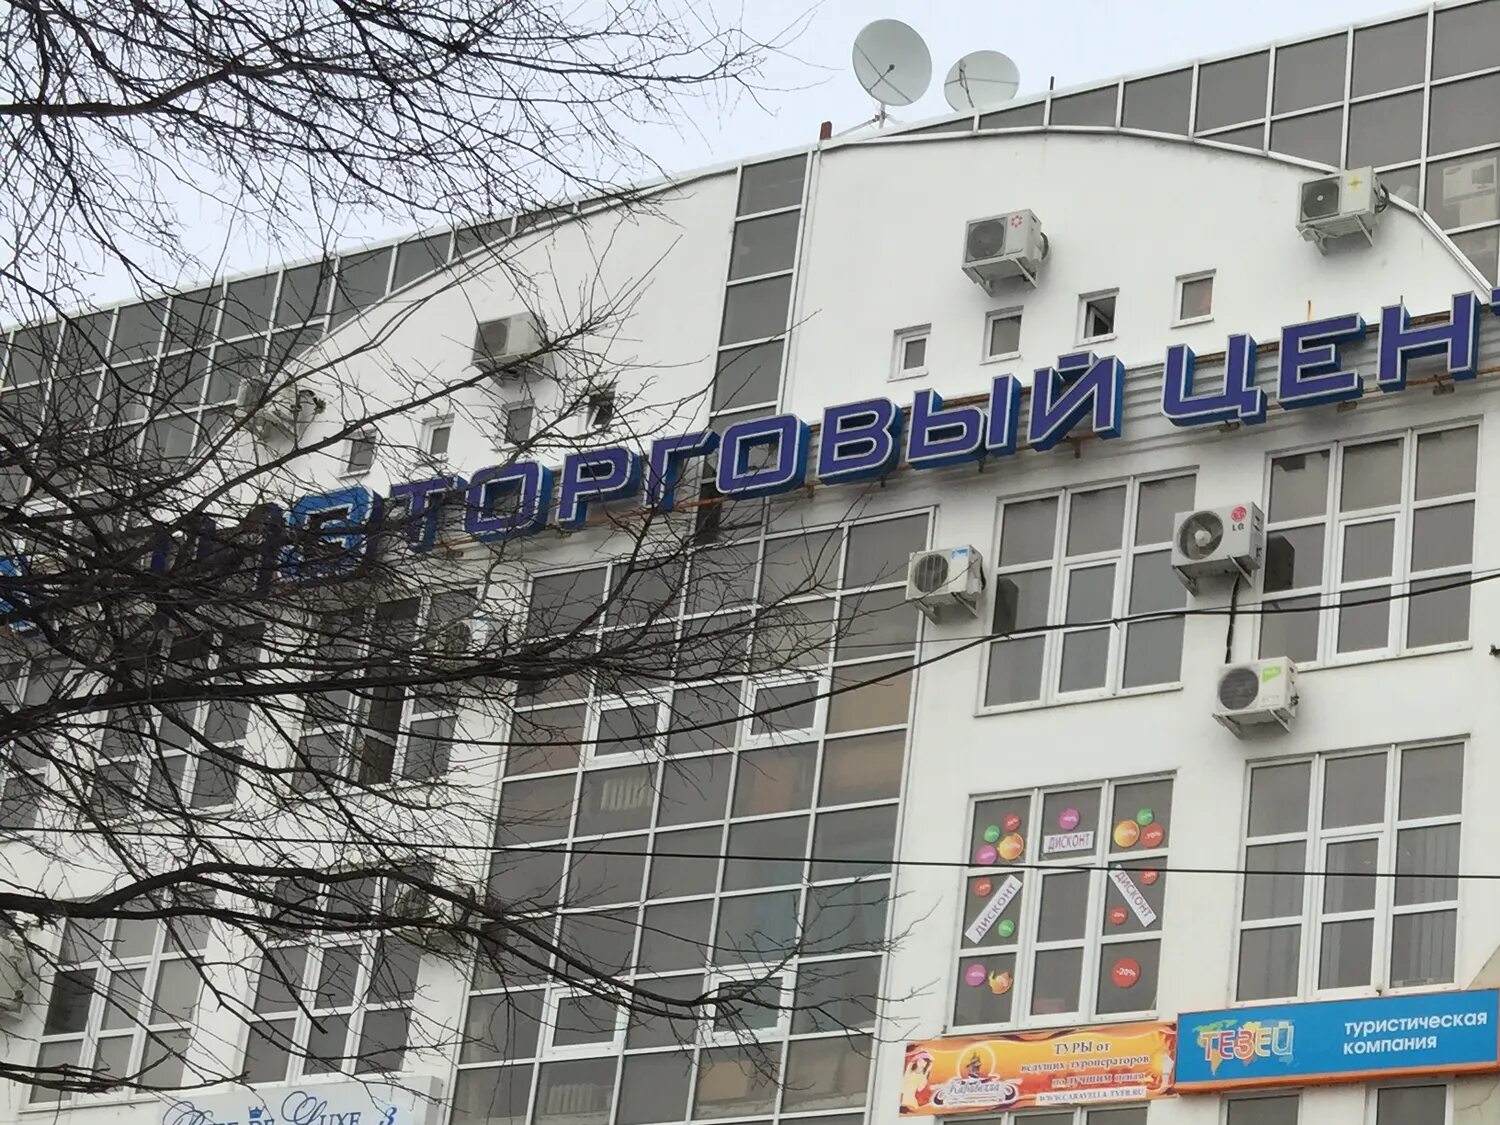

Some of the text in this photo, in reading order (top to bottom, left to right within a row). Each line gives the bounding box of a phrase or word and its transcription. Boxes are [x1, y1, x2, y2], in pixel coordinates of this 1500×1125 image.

[390, 350, 1125, 552] ТОРГОВЫЙ
[1047, 833, 1091, 851] ДИСКОНТ
[1115, 871, 1152, 919] ДИСКОНТ
[975, 882, 1017, 937] ДИСКОНТ
[1344, 1011, 1488, 1038] туристическая
[1054, 1041, 1093, 1055] ТУРЫ
[1343, 1035, 1438, 1056] компания
[1071, 1055, 1150, 1069] туроператоров
